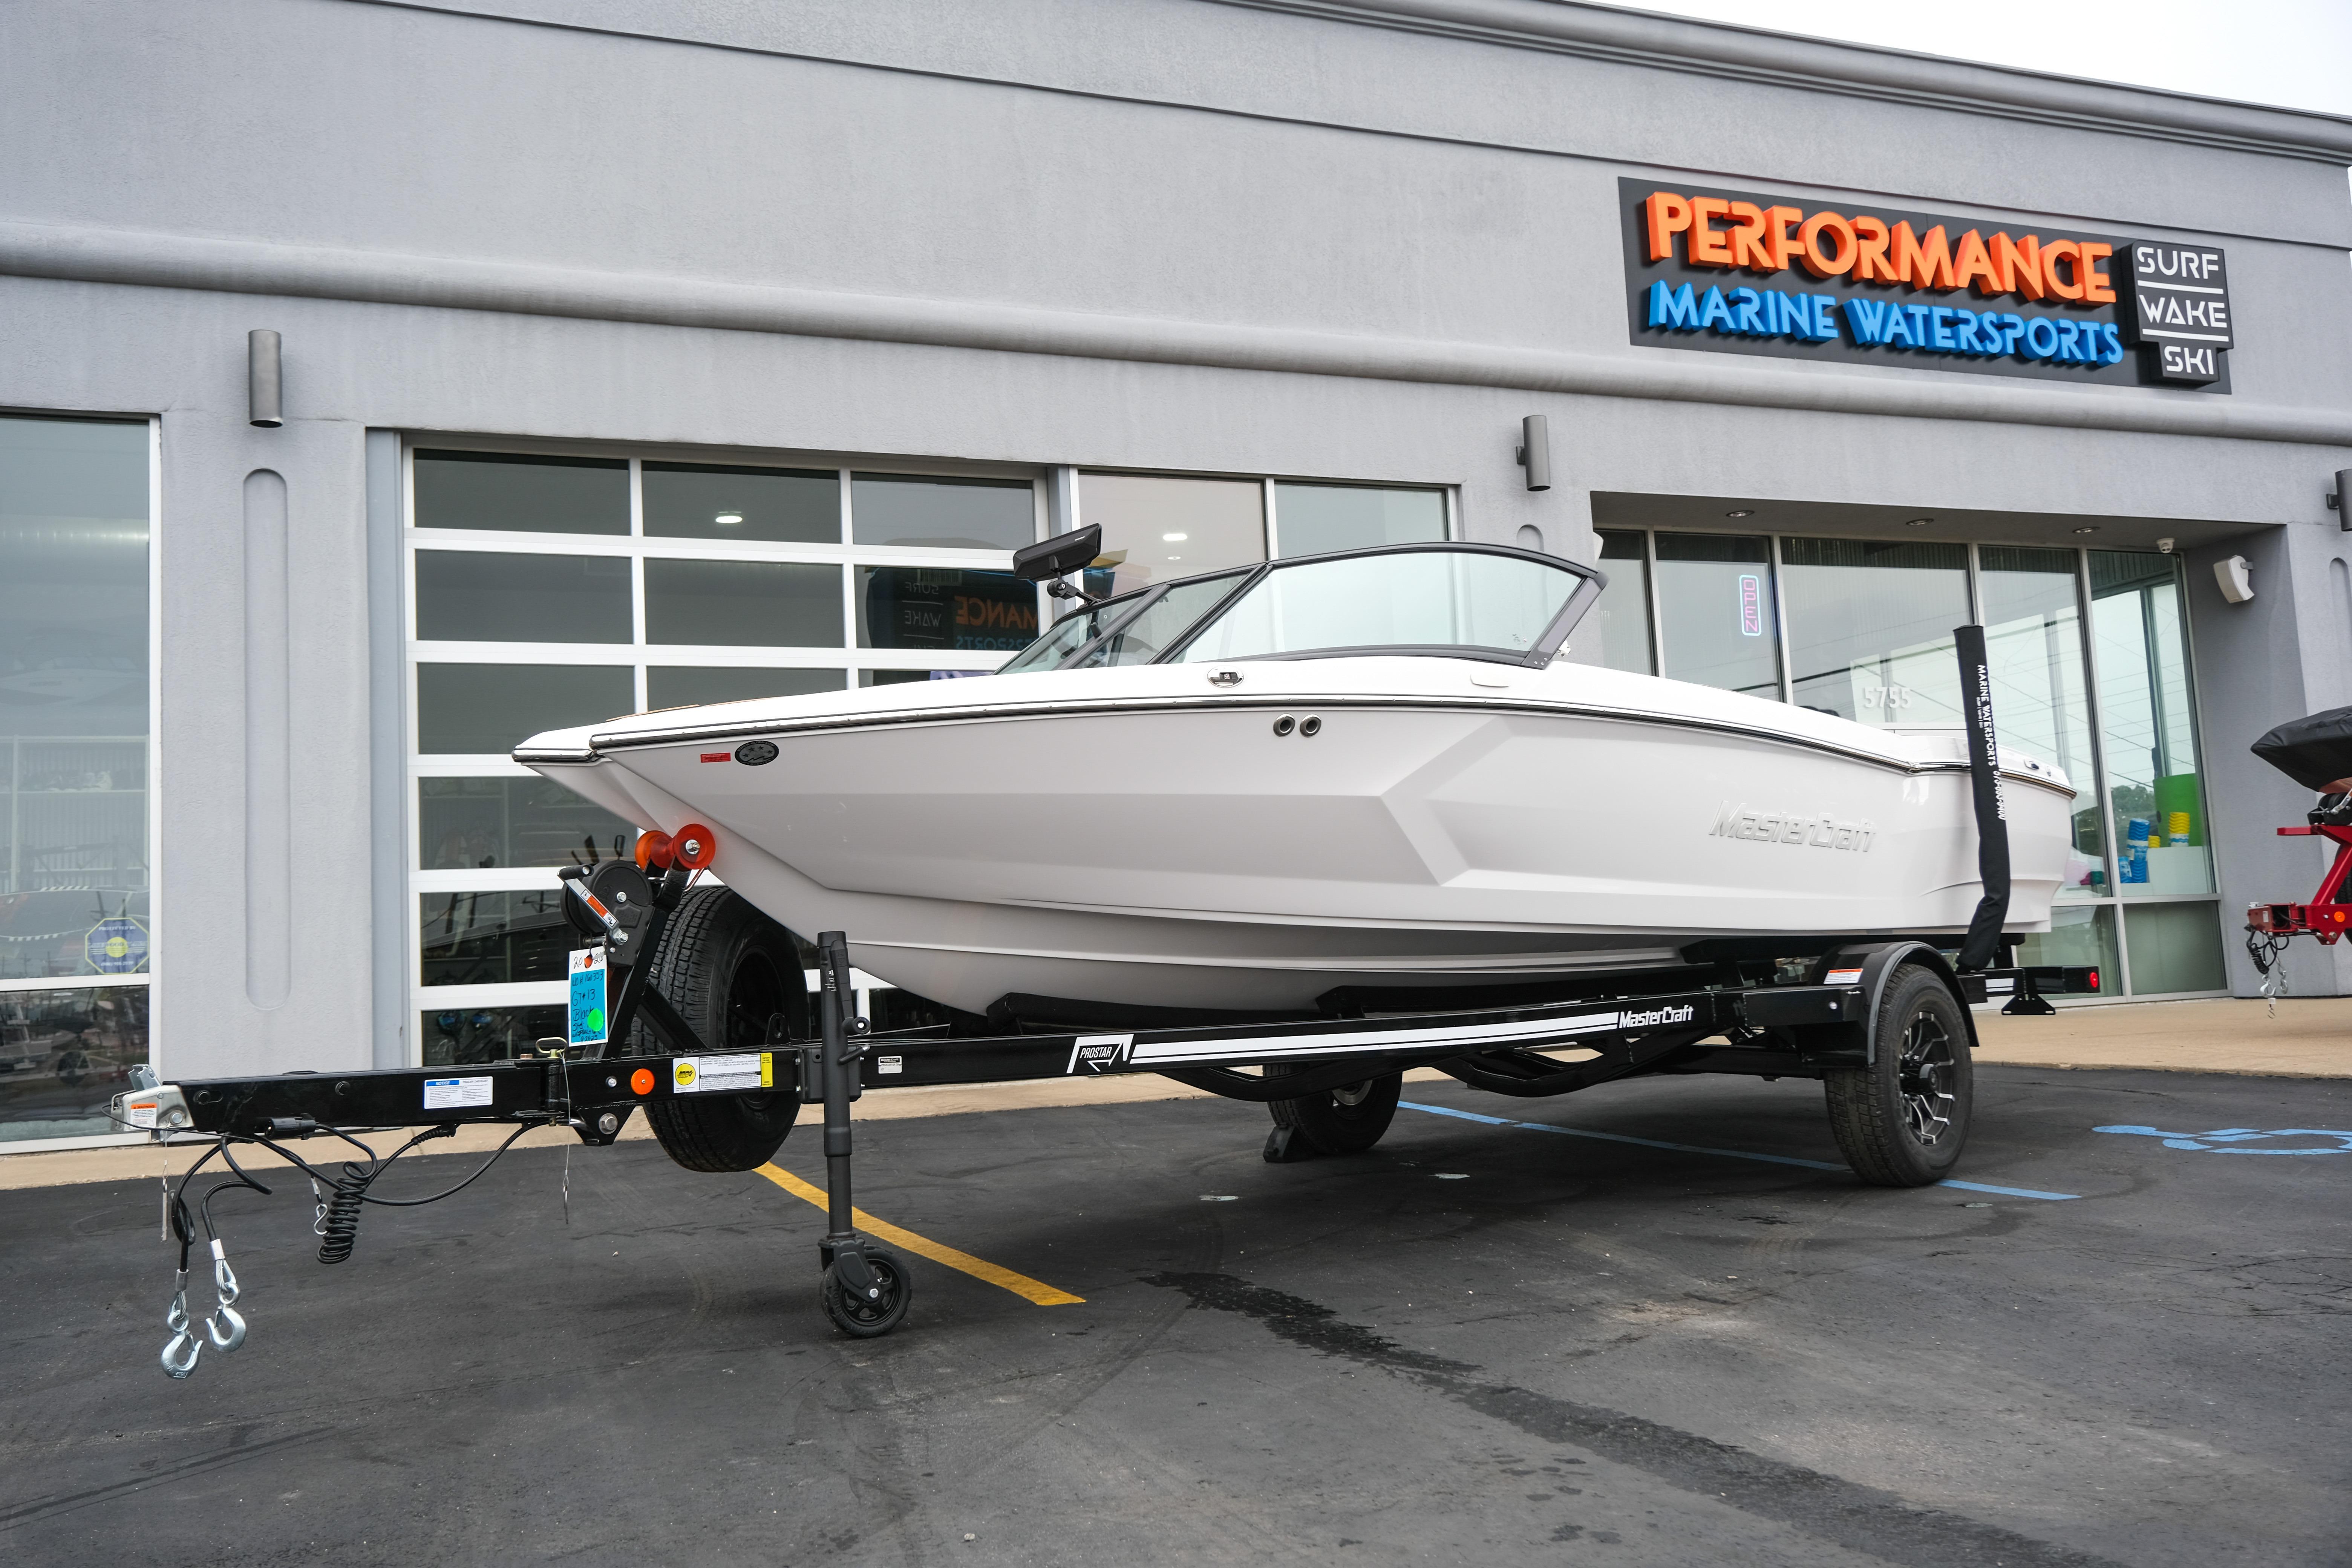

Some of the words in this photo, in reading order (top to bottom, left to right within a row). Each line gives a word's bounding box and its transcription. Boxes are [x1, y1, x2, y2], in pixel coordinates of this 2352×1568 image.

[1647, 192, 2116, 306] PERFORMANCE
[2137, 247, 2219, 279] SURF
[1649, 279, 1839, 342] MARINE
[1843, 298, 2124, 367] WATERSPORTS
[2139, 295, 2227, 328] WAKE
[2164, 346, 2214, 375] SKI
[1743, 579, 1757, 632] OPEN
[1864, 687, 1912, 709] 5755
[1977, 665, 1989, 702] MARINE
[1982, 705, 1997, 766] WATERSPORTS
[1709, 800, 1877, 851] MasterCraft
[1619, 1004, 1693, 1028] MasterCraft
[1080, 1046, 1112, 1059] PROSTAR
